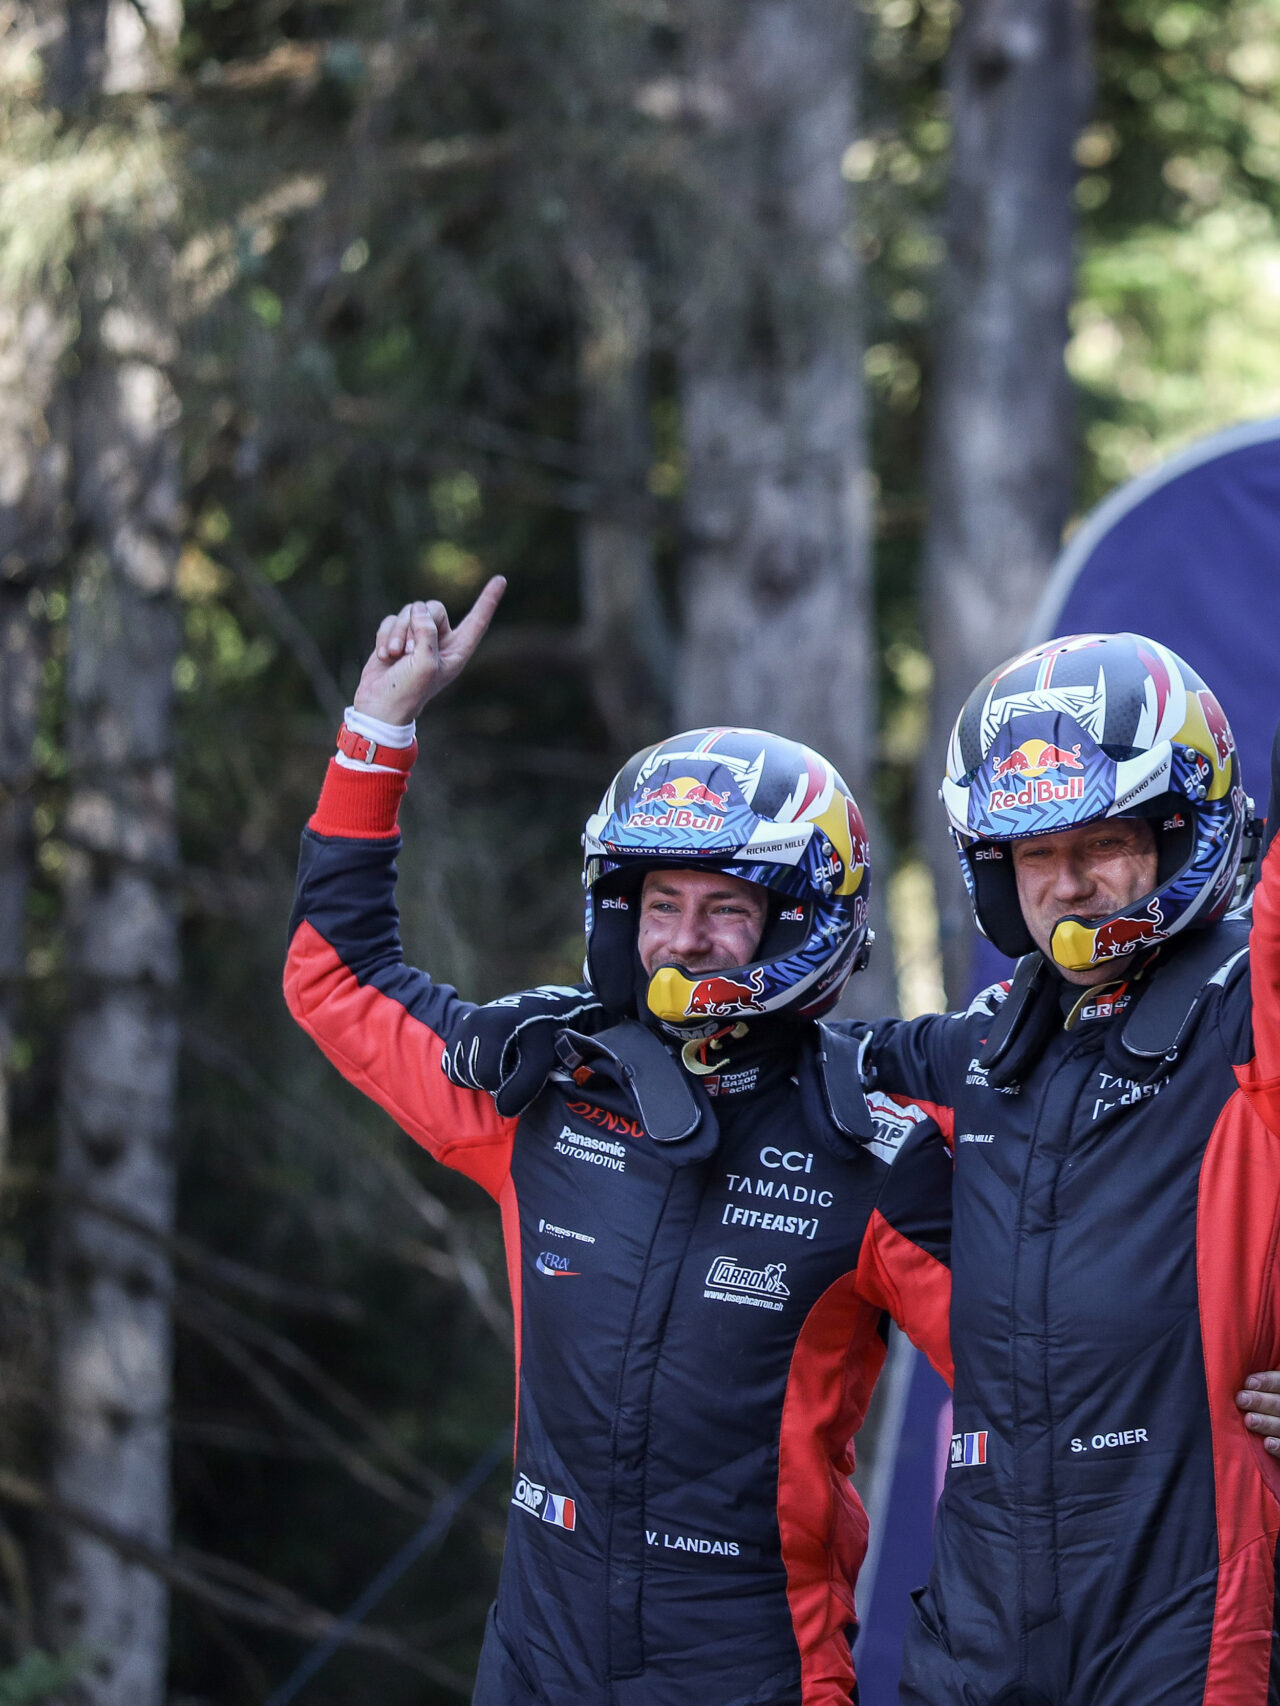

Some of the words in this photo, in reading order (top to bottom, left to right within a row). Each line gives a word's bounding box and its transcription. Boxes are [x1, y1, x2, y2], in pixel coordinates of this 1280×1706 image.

[987, 779, 1033, 813] Red
[1035, 777, 1085, 803] Bull
[1117, 781, 1149, 809] RICHARD
[1149, 762, 1169, 784] MILLE
[623, 808, 676, 829] Red
[674, 810, 724, 833] Bull
[616, 846, 657, 855] TOYOTA
[658, 847, 698, 855] GAZOO
[700, 845, 738, 855] Racing
[746, 843, 783, 856] RICHARD
[784, 839, 806, 850] MILLE
[1082, 1003, 1112, 1018] GR
[721, 1075, 757, 1088] GAZOO
[722, 1067, 759, 1081] TOYOTA
[721, 1083, 756, 1095] Racing
[560, 1125, 627, 1158] Panasonic
[873, 1120, 904, 1142] MP
[553, 1141, 626, 1172] AUTOMOTIVE
[726, 1174, 834, 1207] TAMADIC
[545, 1222, 596, 1244] OVERSTEER
[706, 1256, 774, 1294] CARRON
[703, 1289, 784, 1311] www.josephcarron.ch
[1070, 1437, 1088, 1453] S.
[1091, 1428, 1149, 1449] OGIER
[515, 1479, 544, 1510] OMP
[645, 1530, 659, 1546] V.
[664, 1534, 740, 1556] LANDAIS
